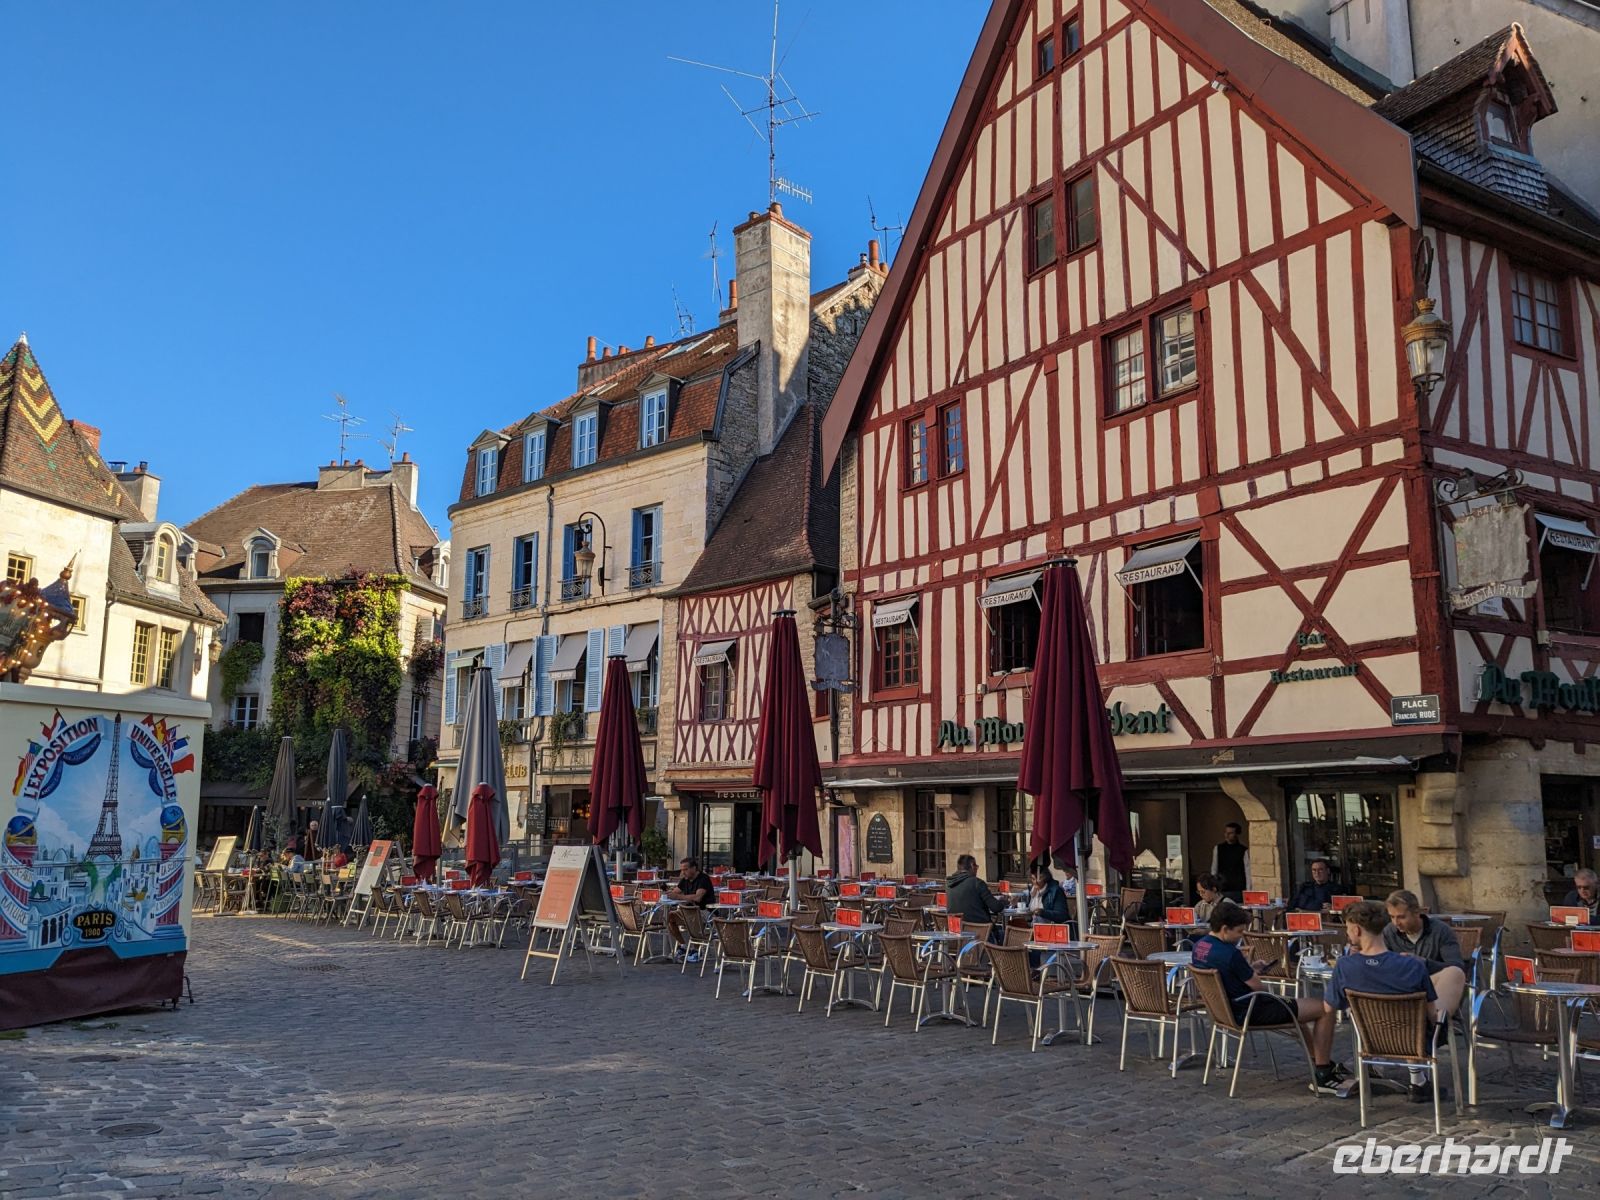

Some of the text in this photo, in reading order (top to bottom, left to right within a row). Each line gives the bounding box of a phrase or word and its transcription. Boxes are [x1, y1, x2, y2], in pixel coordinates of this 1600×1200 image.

[1122, 561, 1181, 583] RESTAURANT
[983, 589, 1030, 607] RESTAURANT
[1464, 583, 1526, 606] RESTAURANT
[874, 613, 906, 626] RESTAURANT
[1297, 631, 1326, 647] Bar
[1270, 662, 1360, 684] Restaurant
[1402, 699, 1428, 709] PLACE
[1419, 710, 1437, 719] RUDE
[937, 719, 970, 748] Au
[23, 717, 177, 801] L'EXPOSITION UNIVERSELLE
[77, 912, 113, 927] PARIS
[85, 928, 101, 937] 1900
